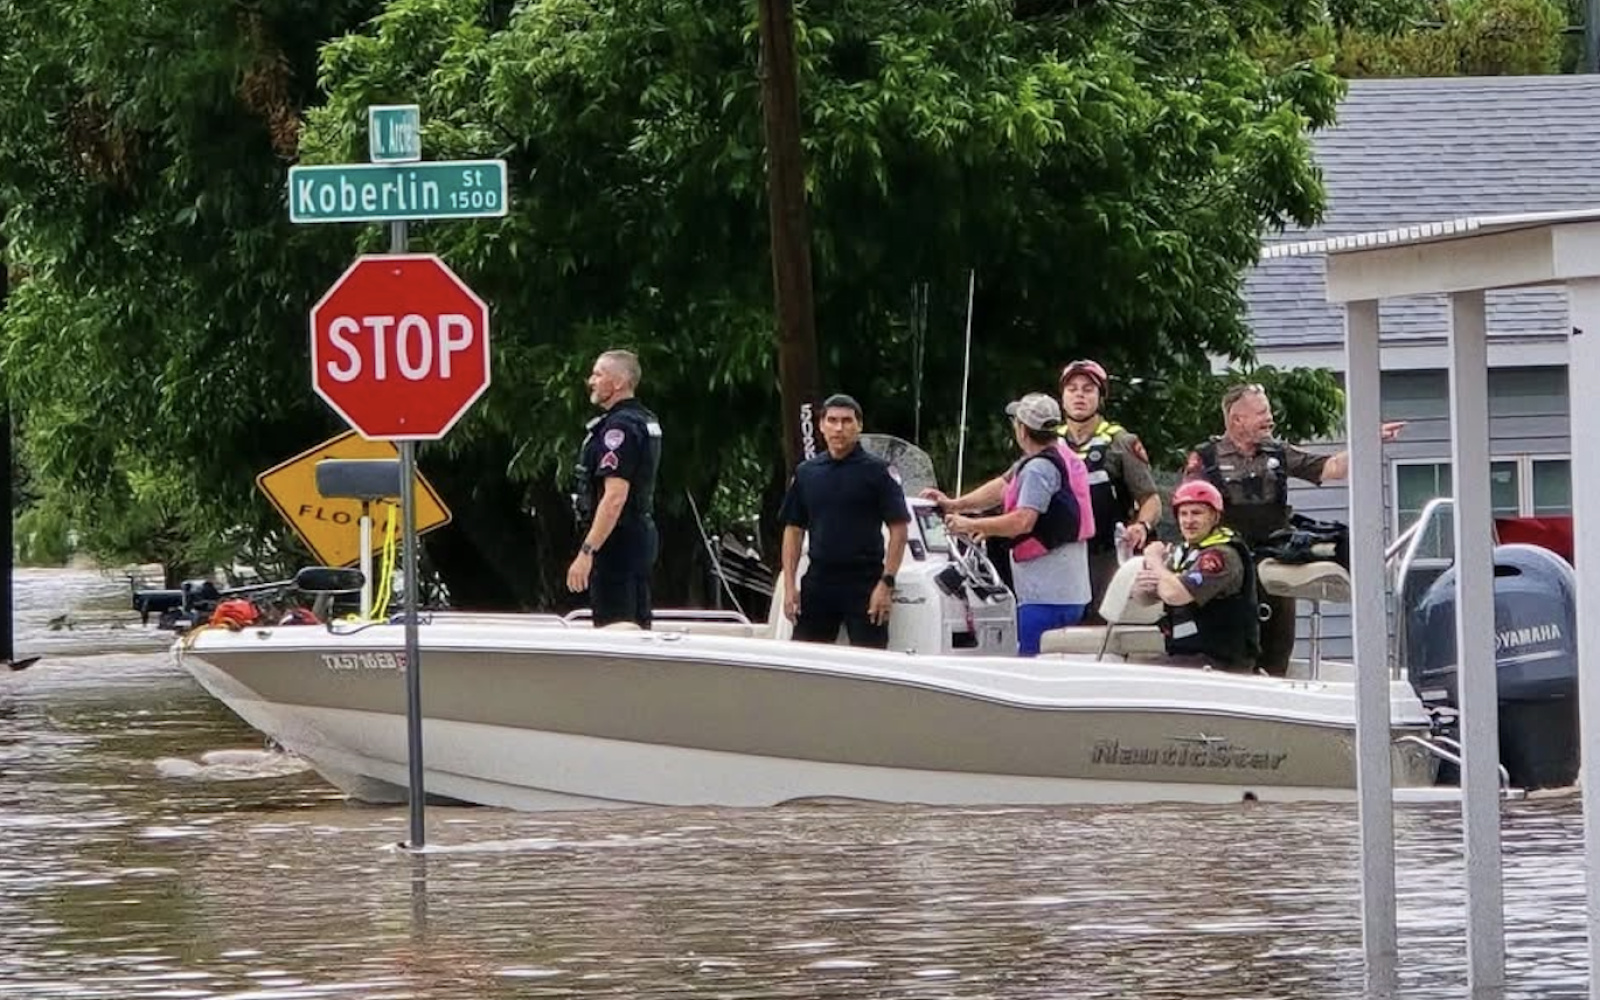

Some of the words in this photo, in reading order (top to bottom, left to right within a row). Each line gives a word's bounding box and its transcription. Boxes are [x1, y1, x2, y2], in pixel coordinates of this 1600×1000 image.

[462, 170, 482, 187] St
[298, 172, 439, 213] Koberlin
[450, 191, 497, 209] 1500
[327, 313, 474, 382] STOP
[1500, 624, 1562, 648] YAMAHA
[1091, 739, 1287, 770] NauticStar
